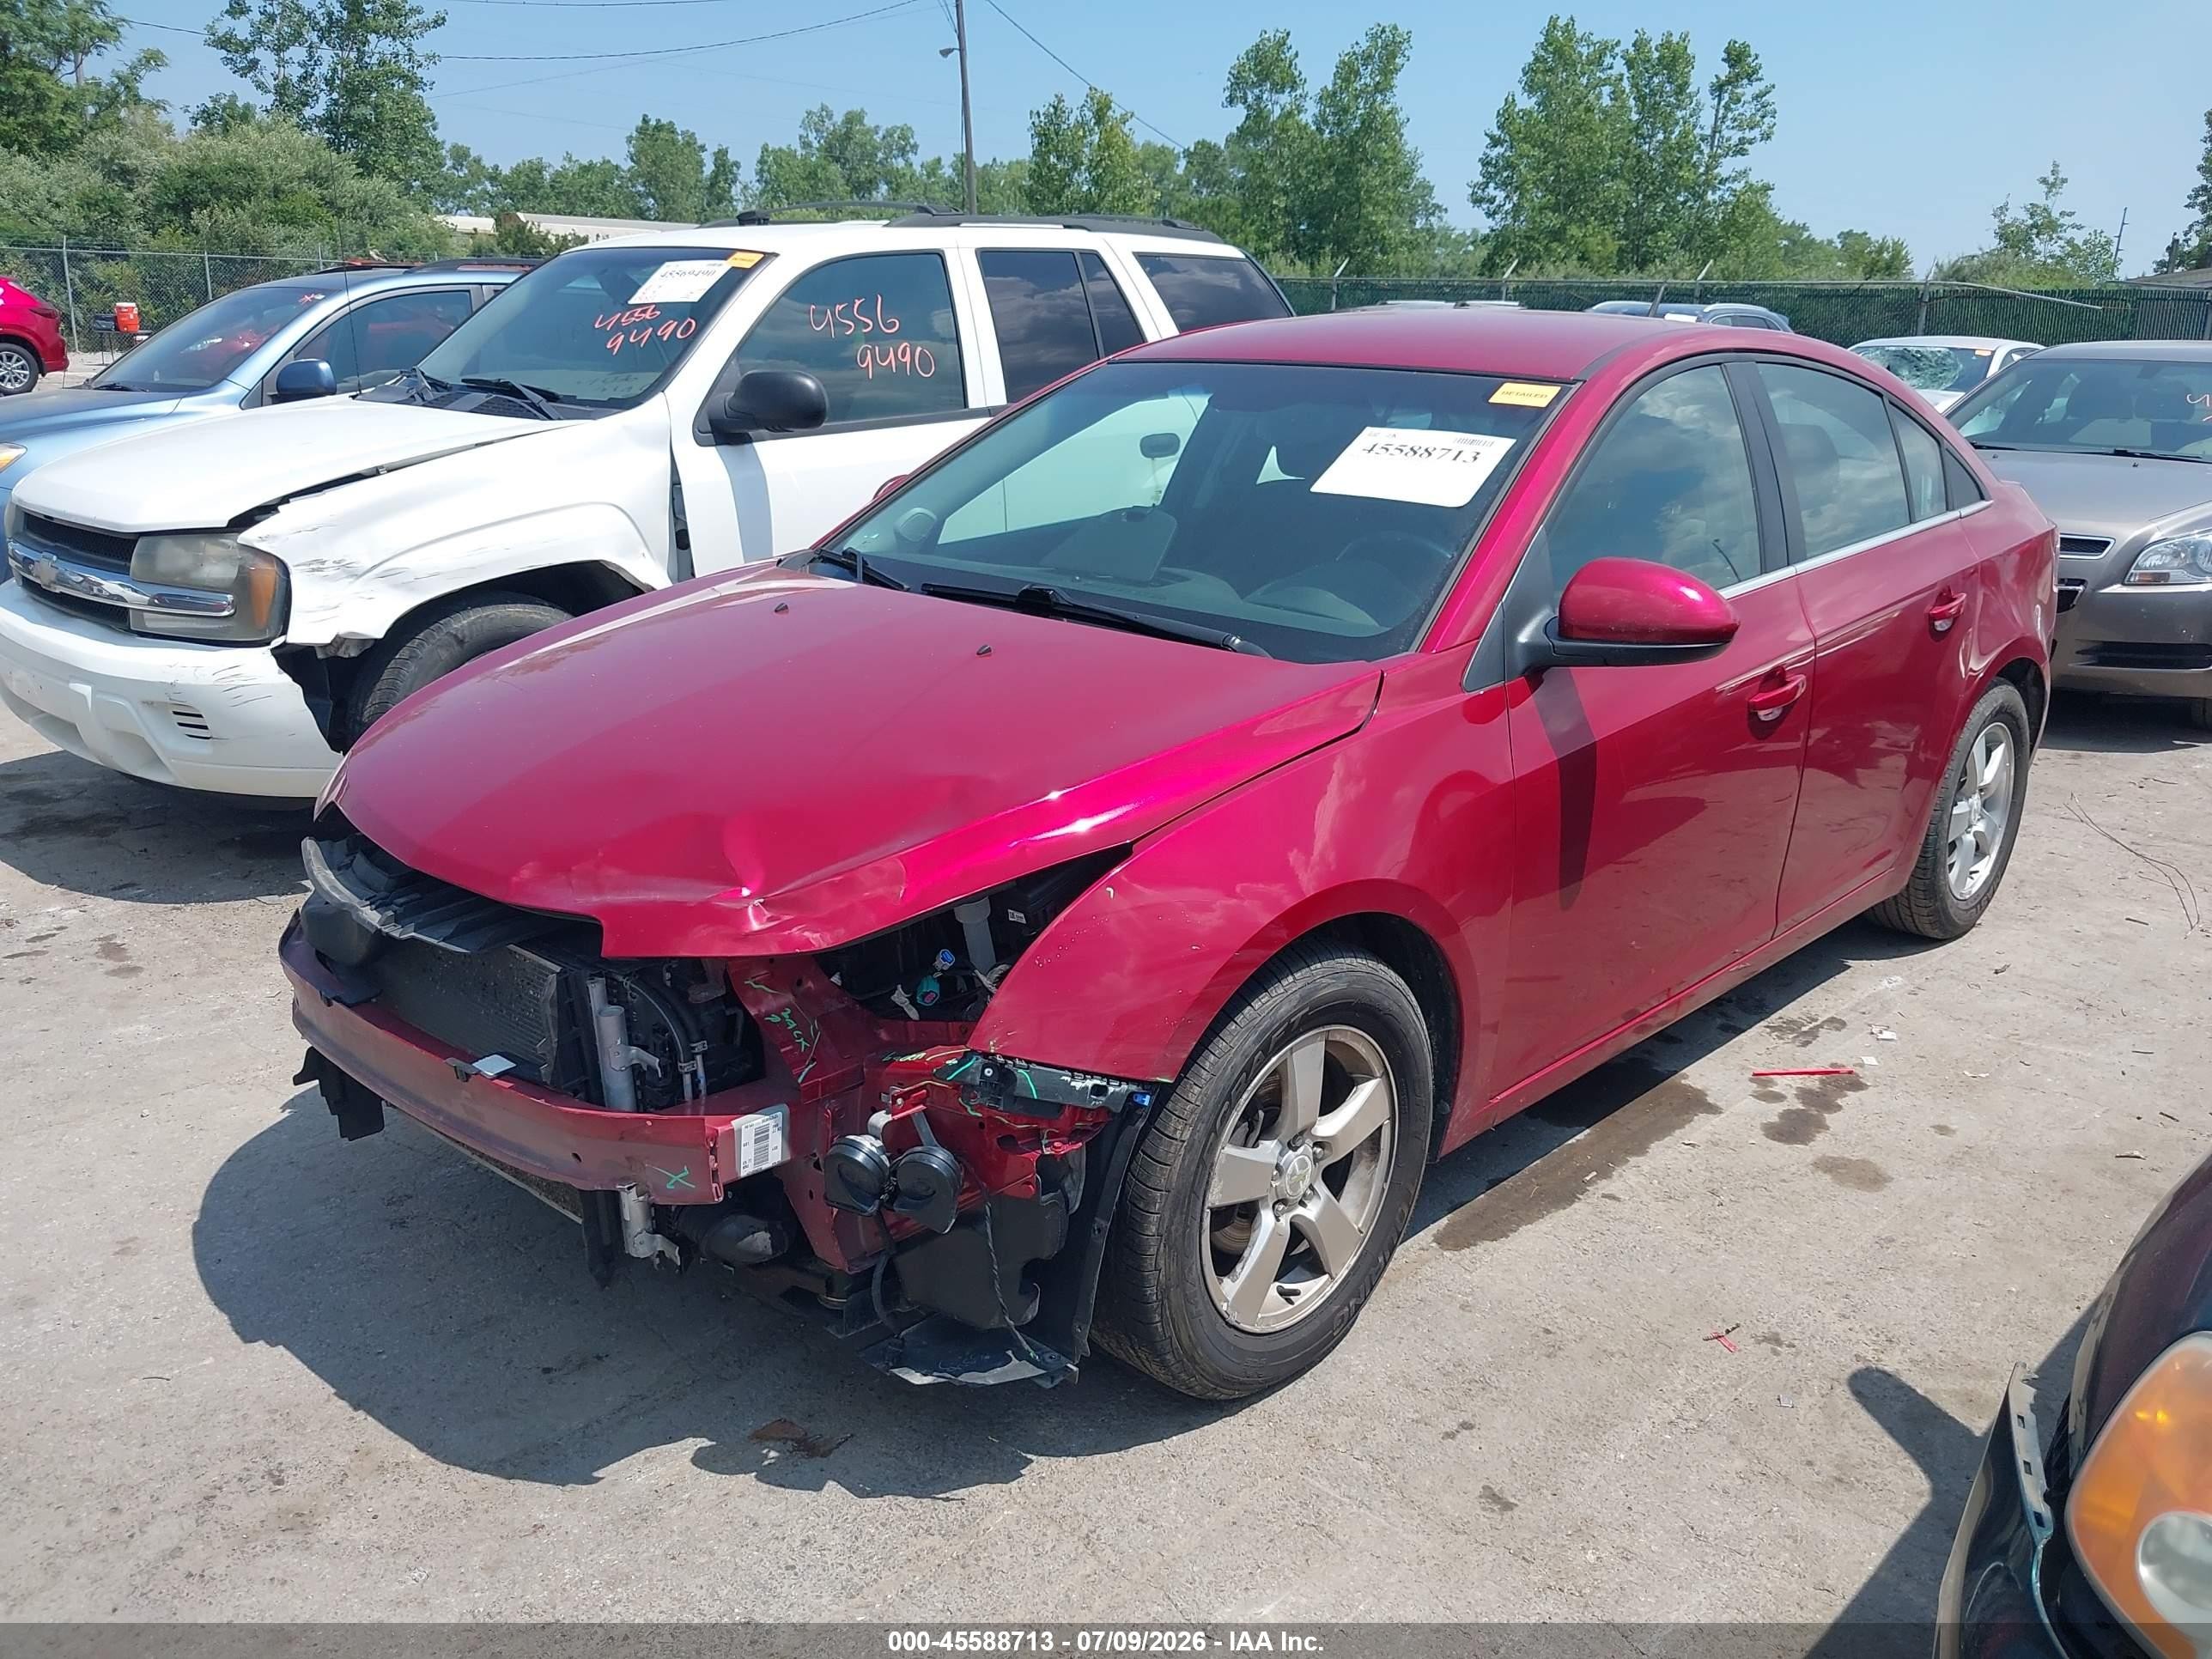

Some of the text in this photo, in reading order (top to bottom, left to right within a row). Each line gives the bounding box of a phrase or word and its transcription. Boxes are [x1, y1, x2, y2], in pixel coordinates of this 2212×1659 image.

[593, 303, 661, 331] 4556
[810, 294, 900, 339] 4556
[606, 317, 696, 356] 9490
[856, 342, 936, 380] 9490
[1362, 442, 1482, 464] 45588713
